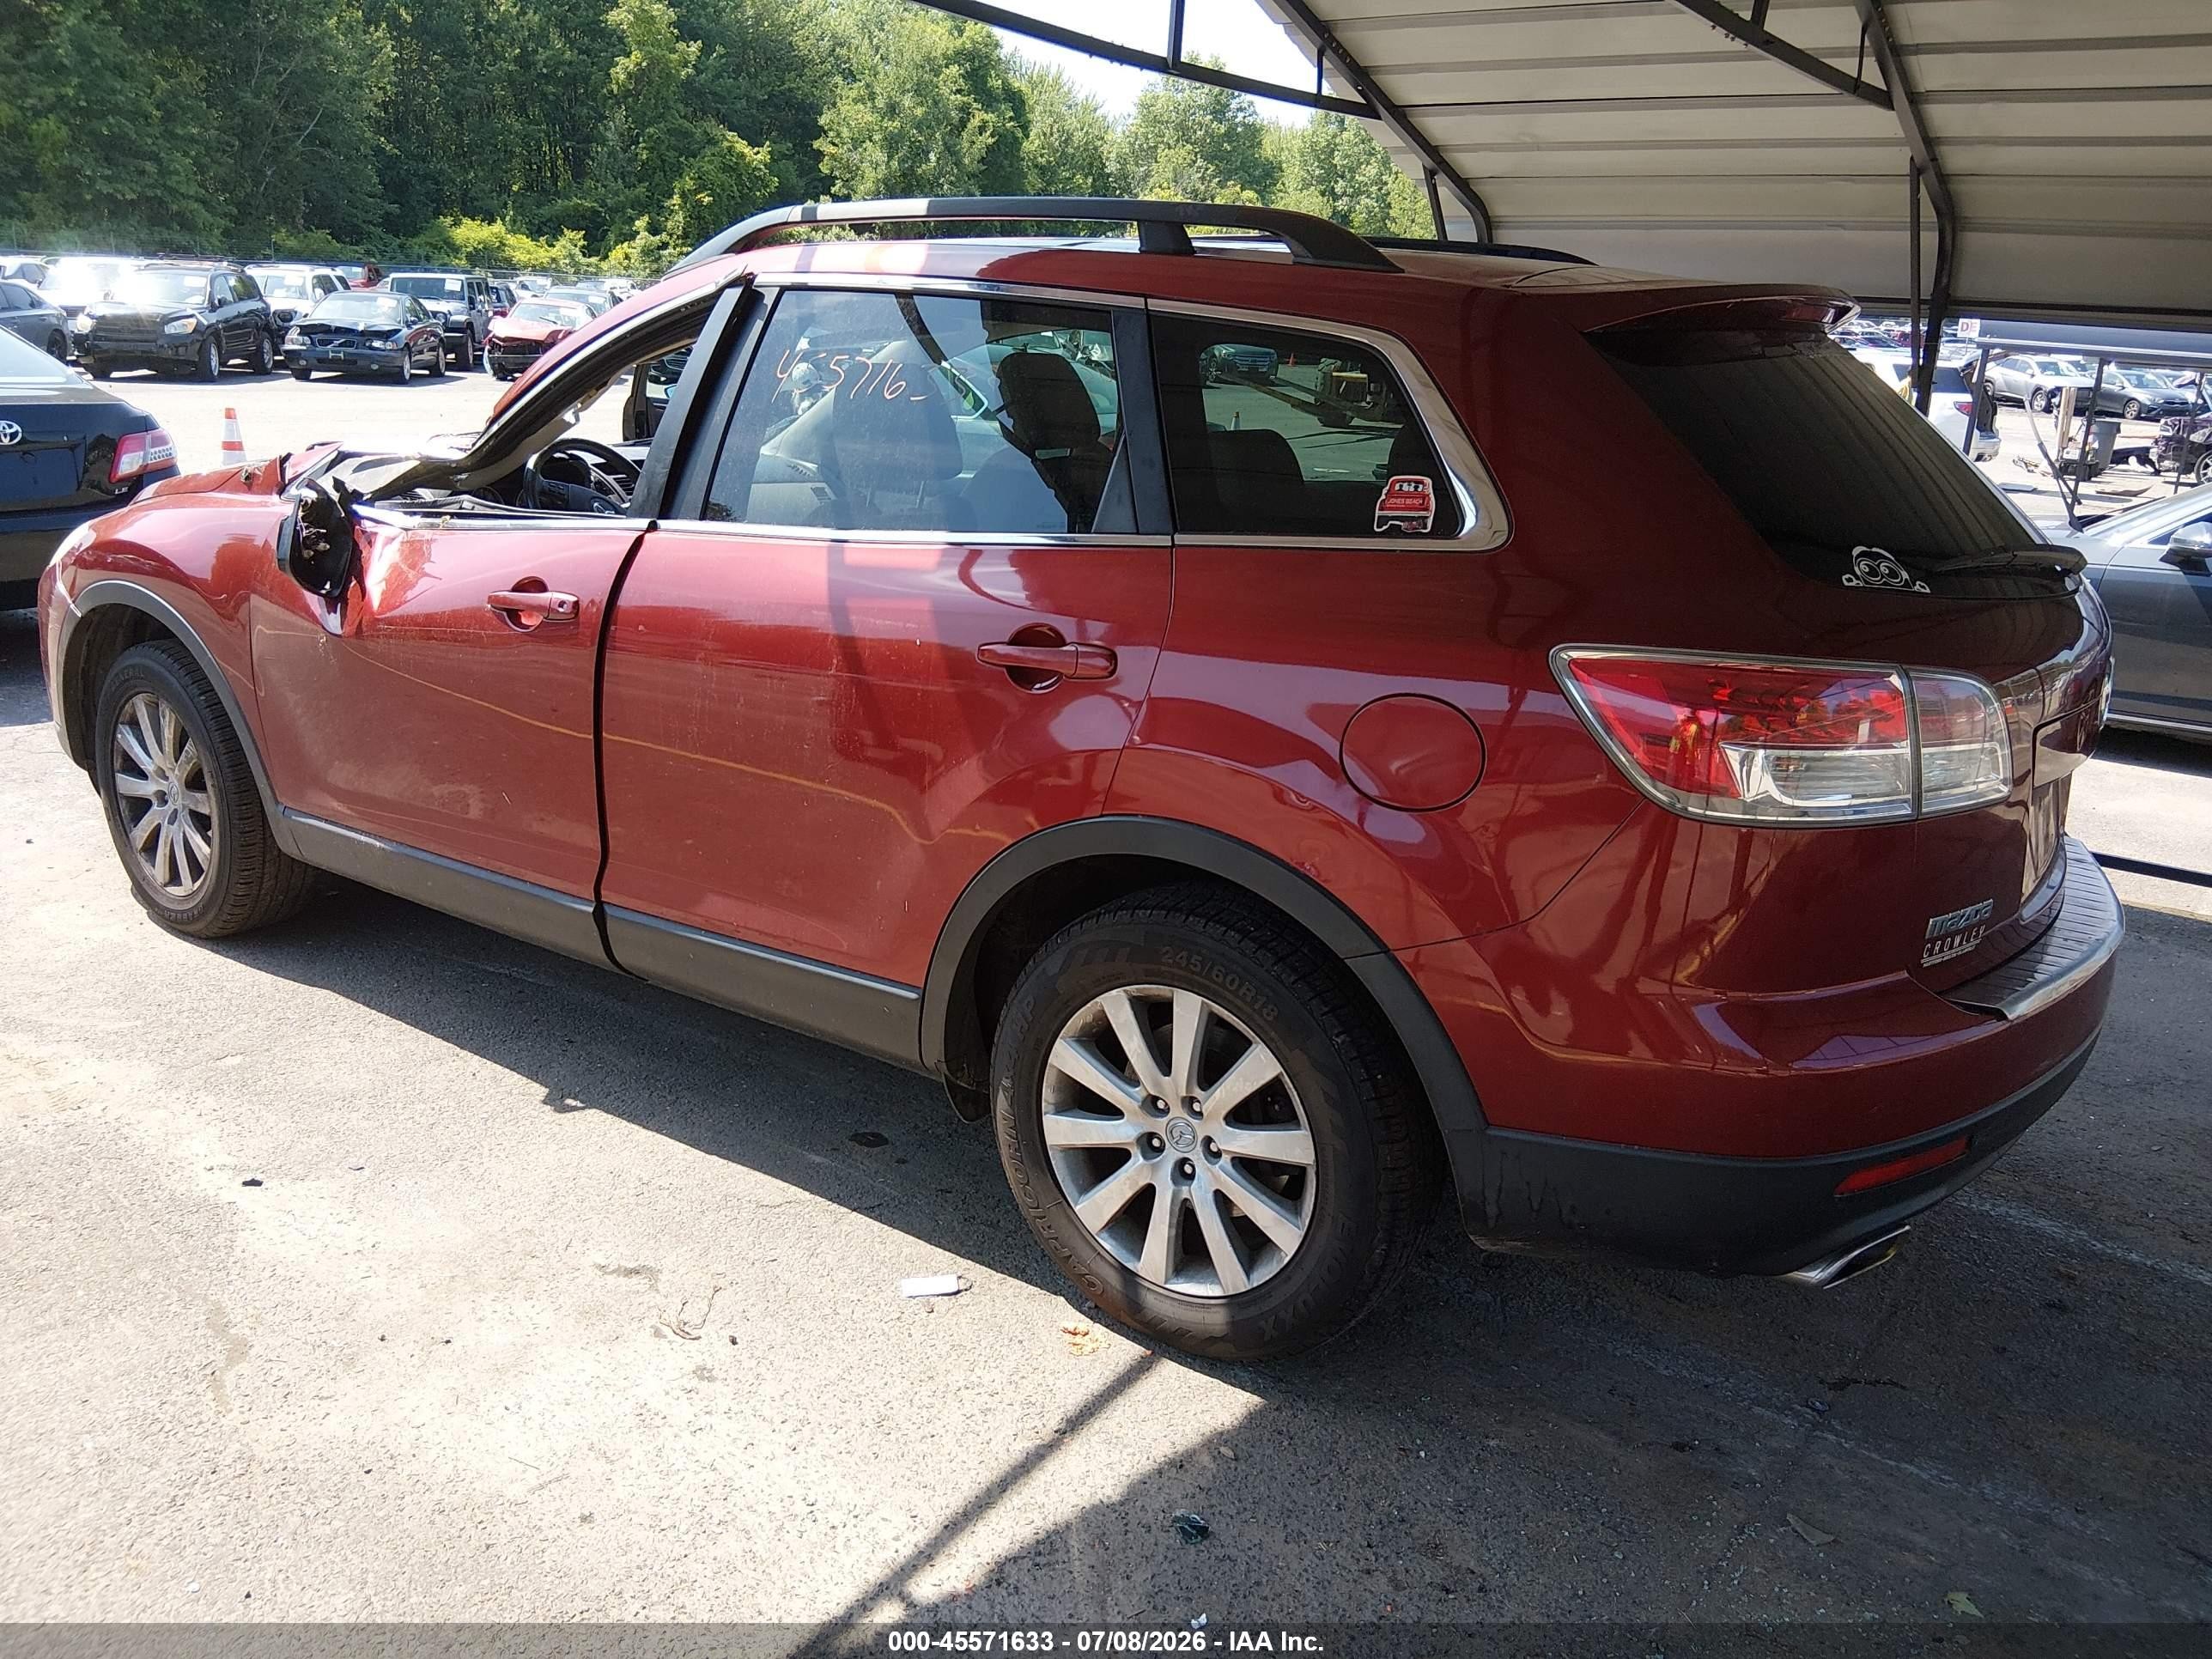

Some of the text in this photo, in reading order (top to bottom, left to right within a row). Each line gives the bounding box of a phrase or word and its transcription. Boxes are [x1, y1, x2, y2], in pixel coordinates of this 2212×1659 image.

[1923, 924, 1986, 958] CROWLEY
[1159, 945, 1279, 1022] 245/60R18
[999, 1110, 1105, 1297] CAPRICORN
